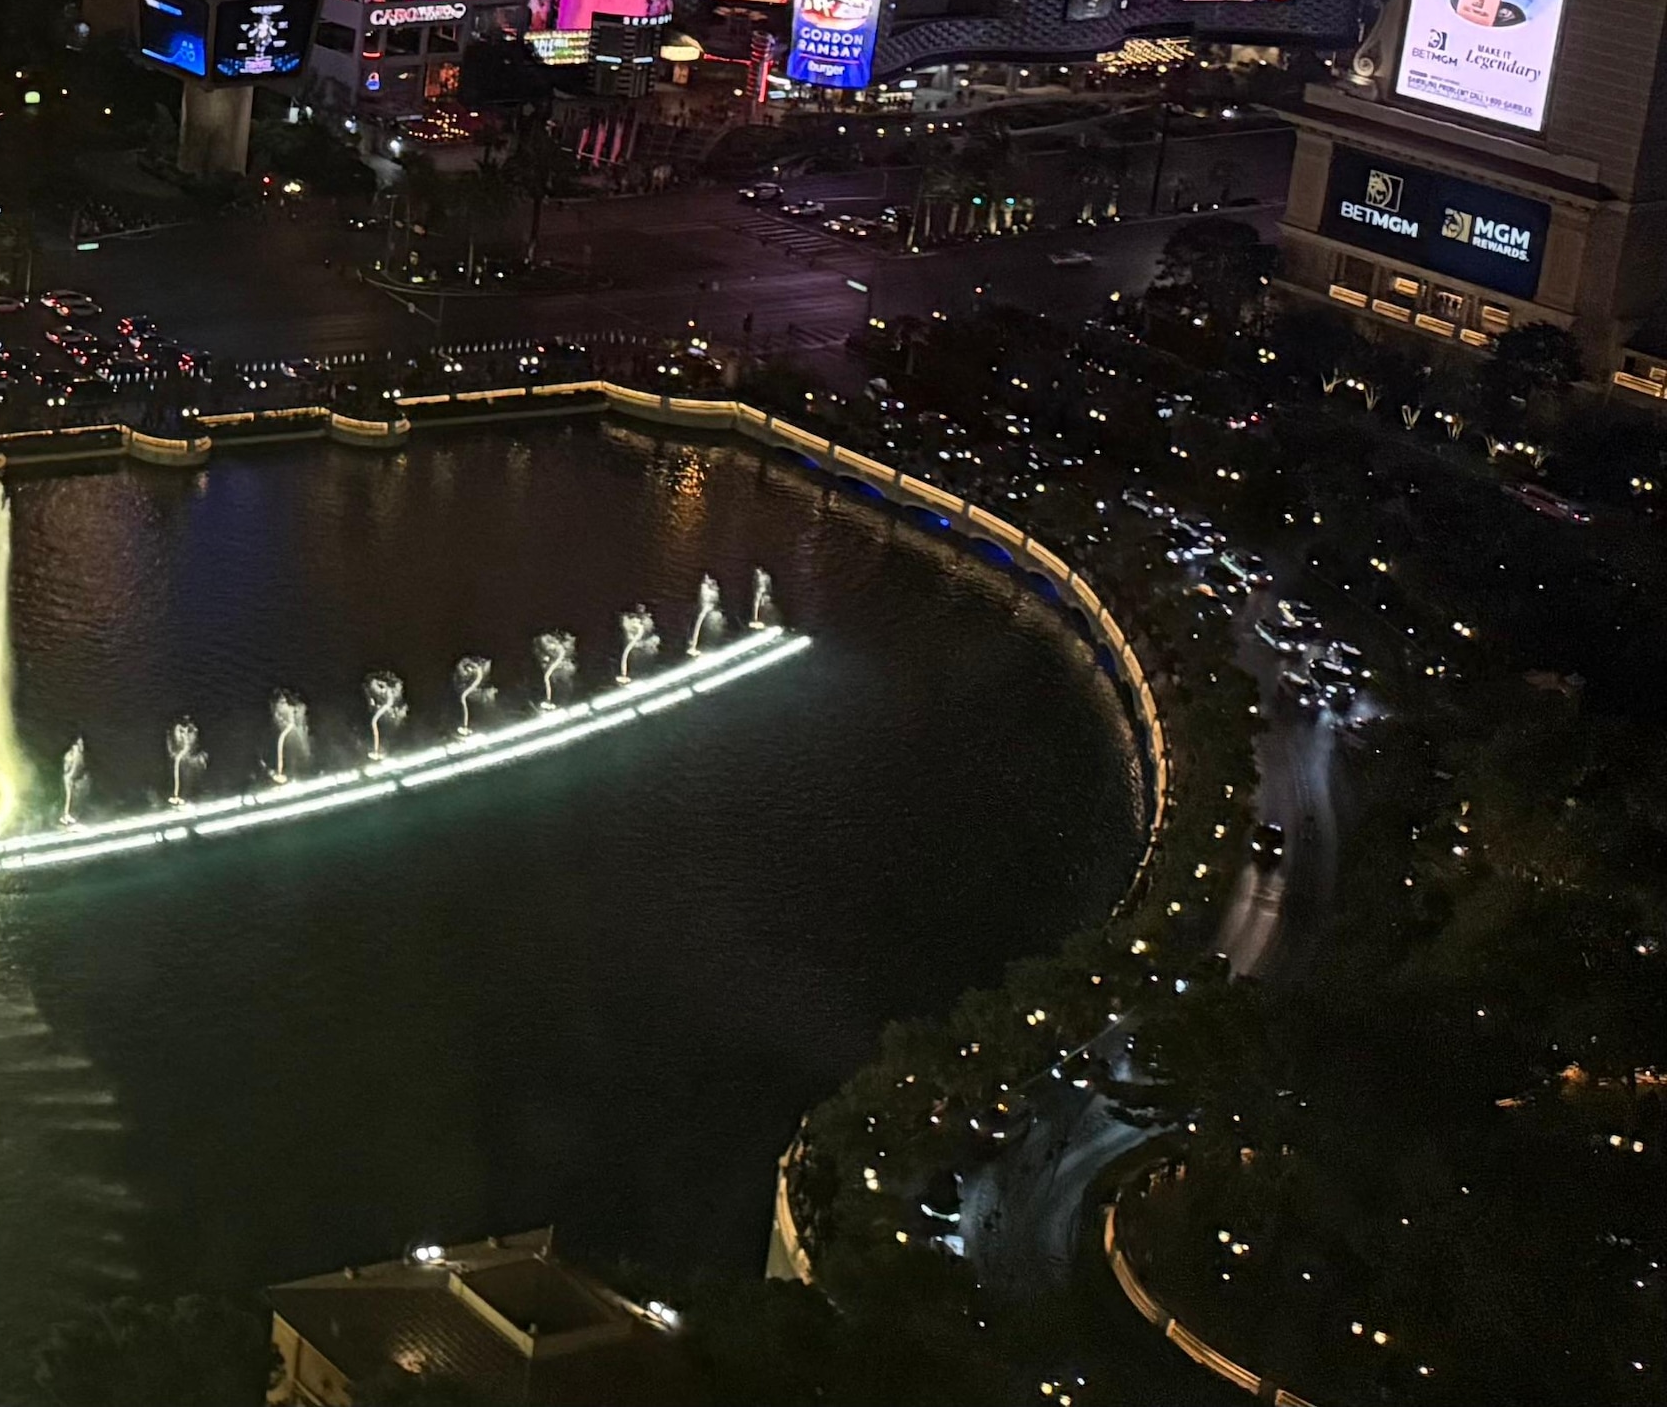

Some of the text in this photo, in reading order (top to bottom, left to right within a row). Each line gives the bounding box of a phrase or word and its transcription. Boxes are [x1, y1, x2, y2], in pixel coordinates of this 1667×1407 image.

[800, 27, 864, 45] GORDON
[798, 39, 863, 59] RAMSAY
[1412, 47, 1458, 67] BETMGM
[1477, 44, 1512, 60] MAKE IT
[807, 60, 845, 76] burger
[1466, 49, 1542, 83] Legendary
[1341, 201, 1419, 238] BETMGM
[1473, 216, 1531, 249] MGM
